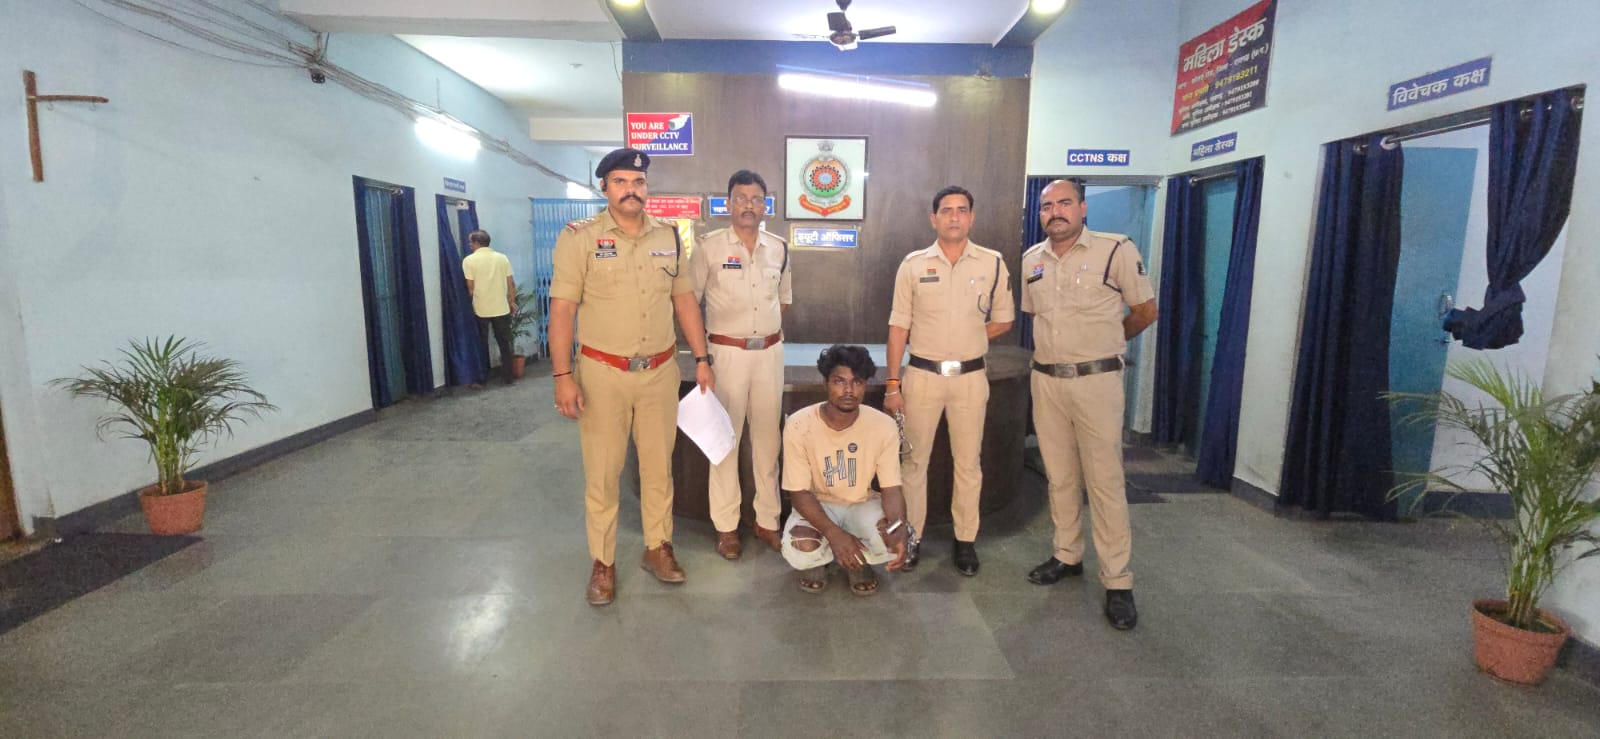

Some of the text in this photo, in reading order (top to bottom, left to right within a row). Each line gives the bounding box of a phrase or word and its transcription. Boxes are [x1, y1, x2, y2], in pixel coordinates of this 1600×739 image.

[1183, 17, 1267, 72] महिला डेस्क
[1392, 67, 1487, 105] विवेचक कक्ष
[630, 122, 665, 130] YOU ARE
[631, 131, 680, 140] UNDER CCTV
[631, 142, 689, 151] SURVEILLANCE
[1192, 139, 1236, 157] महिला डेस्क
[1070, 153, 1128, 163] CCTNS कक्ष
